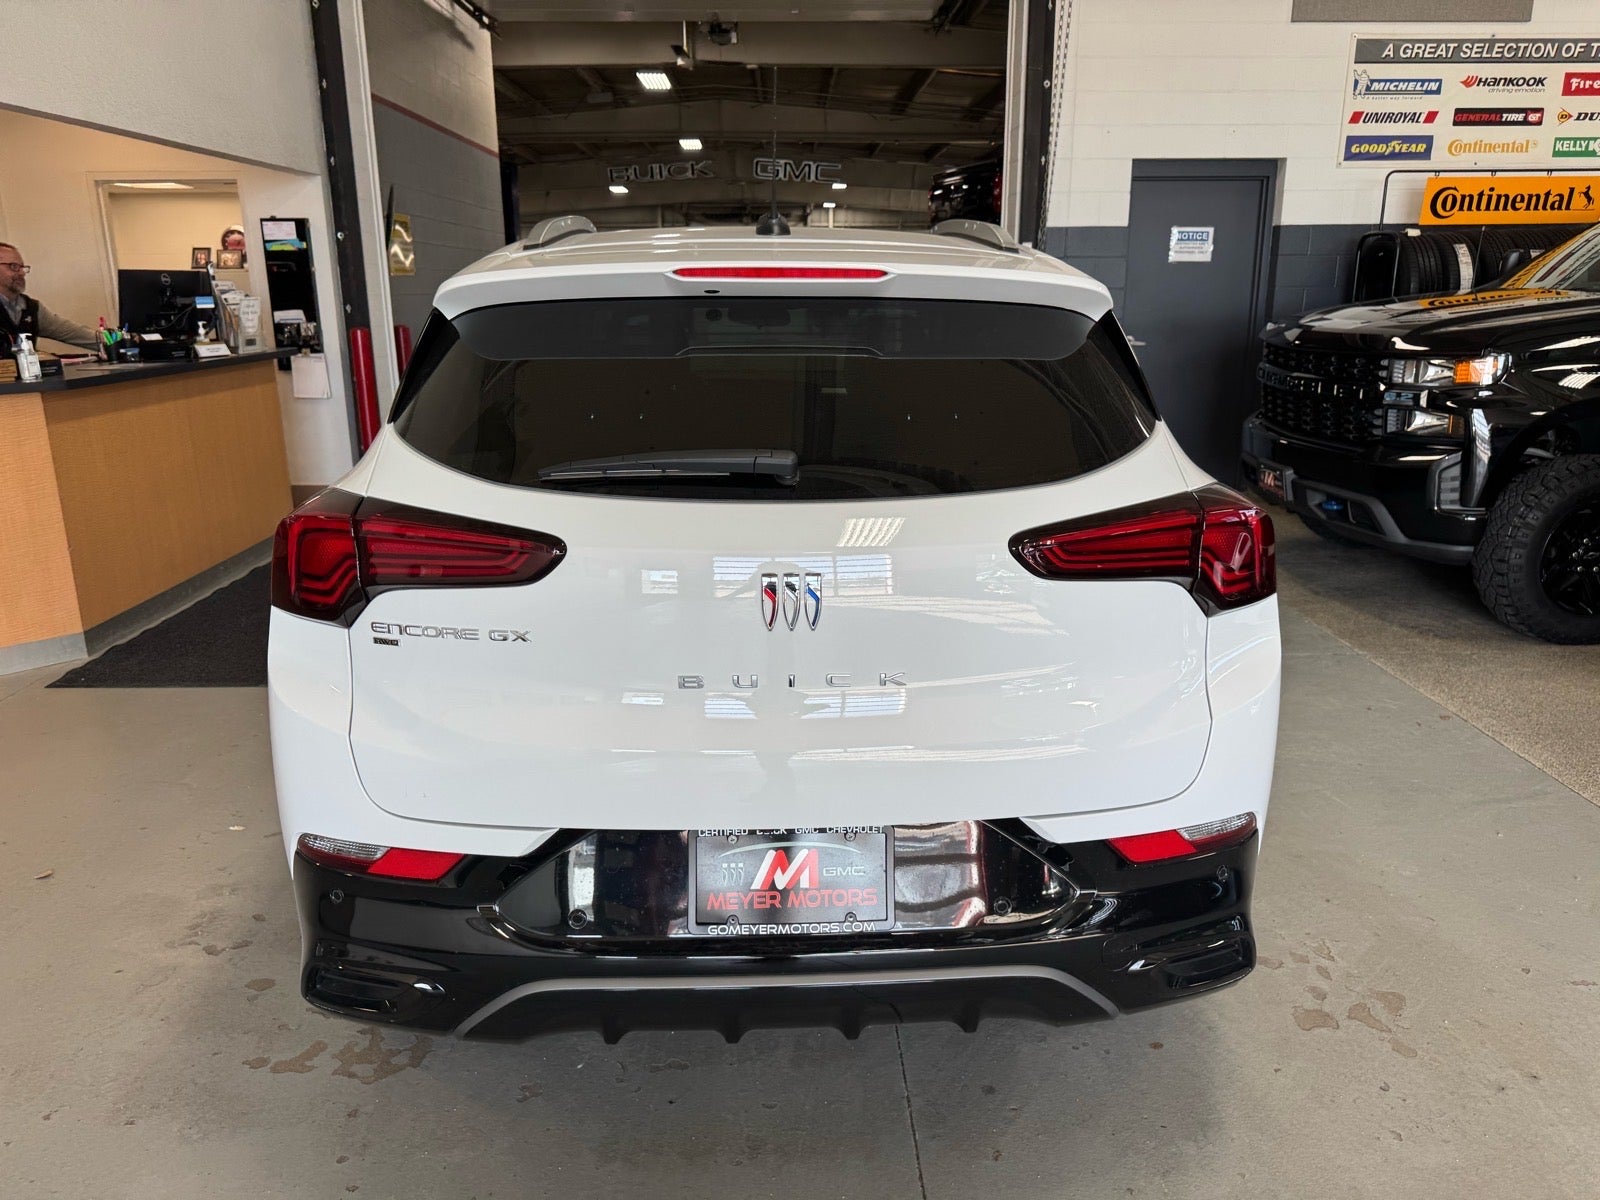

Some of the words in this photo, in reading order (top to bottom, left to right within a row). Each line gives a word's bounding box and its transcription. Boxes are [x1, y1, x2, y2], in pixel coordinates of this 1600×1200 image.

[1381, 43, 1394, 58] A
[1400, 43, 1457, 58] GREAT
[1460, 43, 1558, 58] SELECTION
[1561, 42, 1587, 58] OF
[1590, 42, 1600, 58] T
[1370, 81, 1440, 91] MICHELIN
[1514, 86, 1546, 94] emotion
[1362, 111, 1423, 123] UNIROYAL
[1455, 112, 1501, 122] GENERAL
[1501, 113, 1526, 121] TIRE
[1574, 112, 1600, 121] DU
[1351, 140, 1427, 155] GOODYEAR
[1447, 139, 1530, 157] Continental
[1555, 140, 1588, 151] KELLY
[608, 160, 714, 183] BUICK
[753, 157, 842, 184] GMC
[1430, 186, 1575, 219] Continental
[1176, 232, 1208, 240] NOTICE
[371, 621, 480, 641] ENCORE
[488, 629, 532, 643] GX
[678, 672, 907, 689] BUICK
[823, 866, 864, 876] GMC
[706, 890, 781, 911] MEYER
[787, 888, 878, 908] MOTORS
[707, 921, 876, 935] GOMEYERMOTORS.COM
